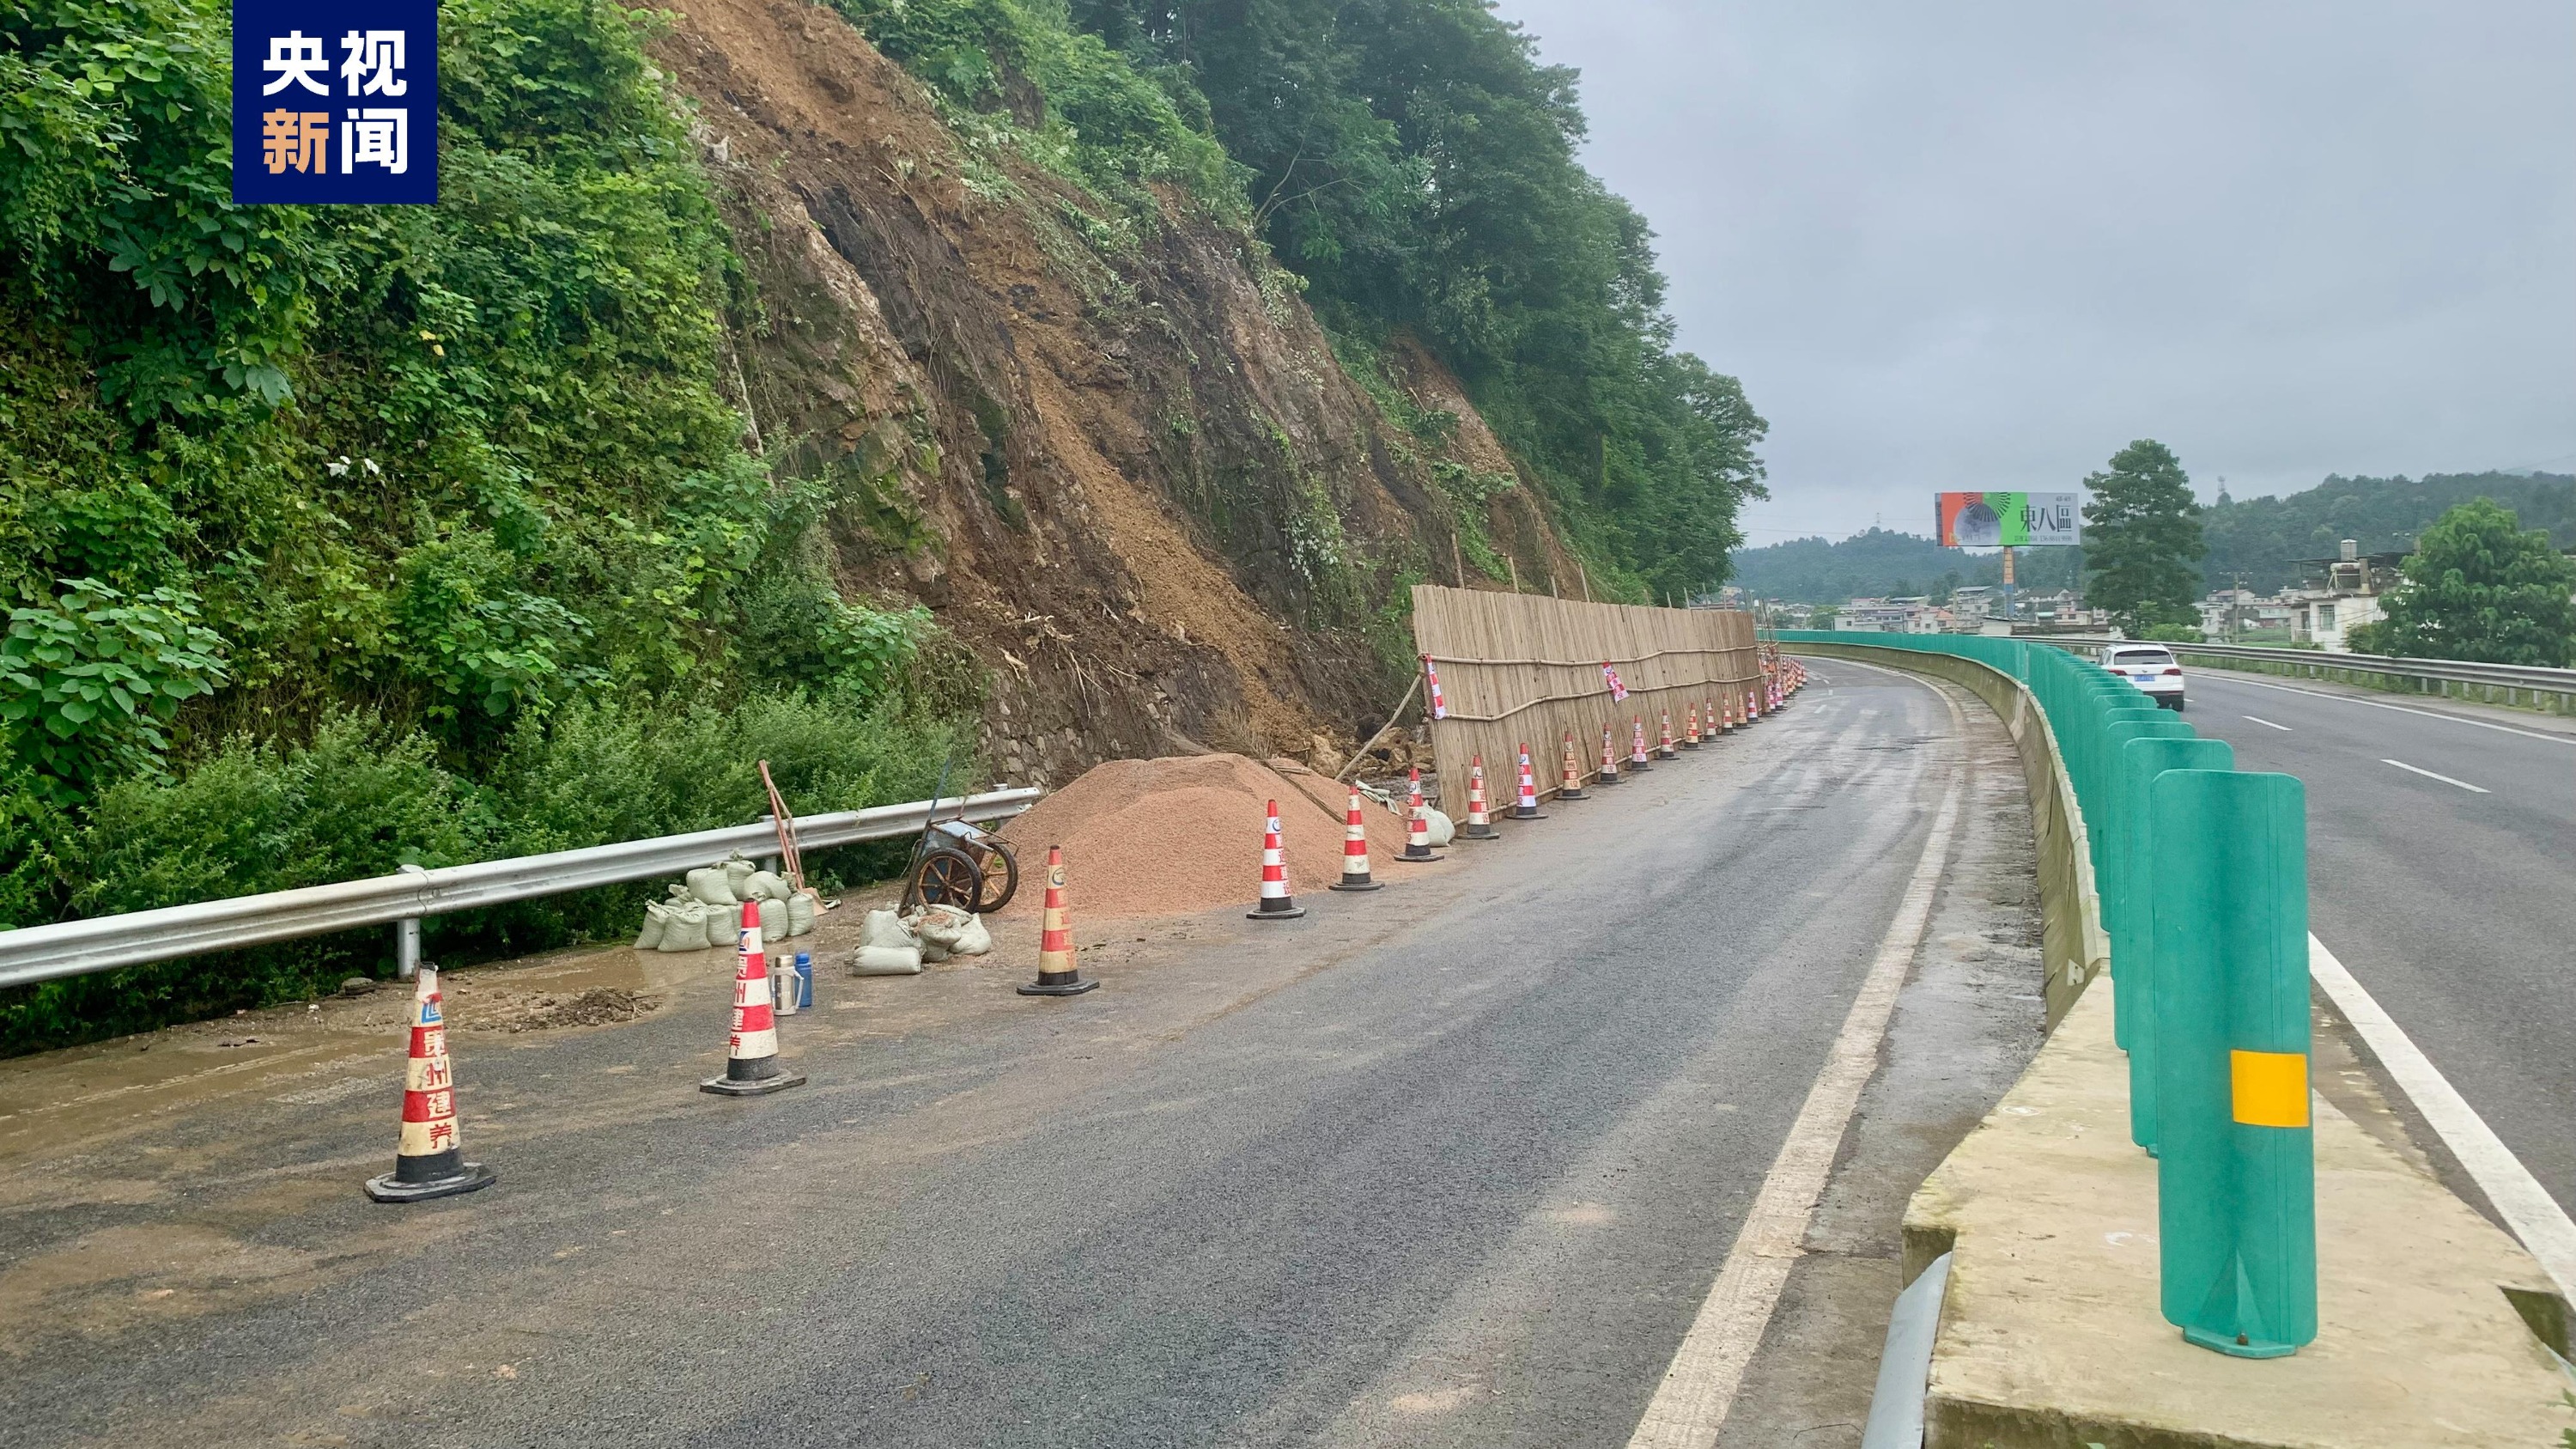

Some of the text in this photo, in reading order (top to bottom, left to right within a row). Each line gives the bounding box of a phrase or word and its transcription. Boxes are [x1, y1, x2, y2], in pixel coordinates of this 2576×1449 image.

[2020, 504, 2072, 533] 東八區
[423, 1030, 452, 1149] 贵州建养
